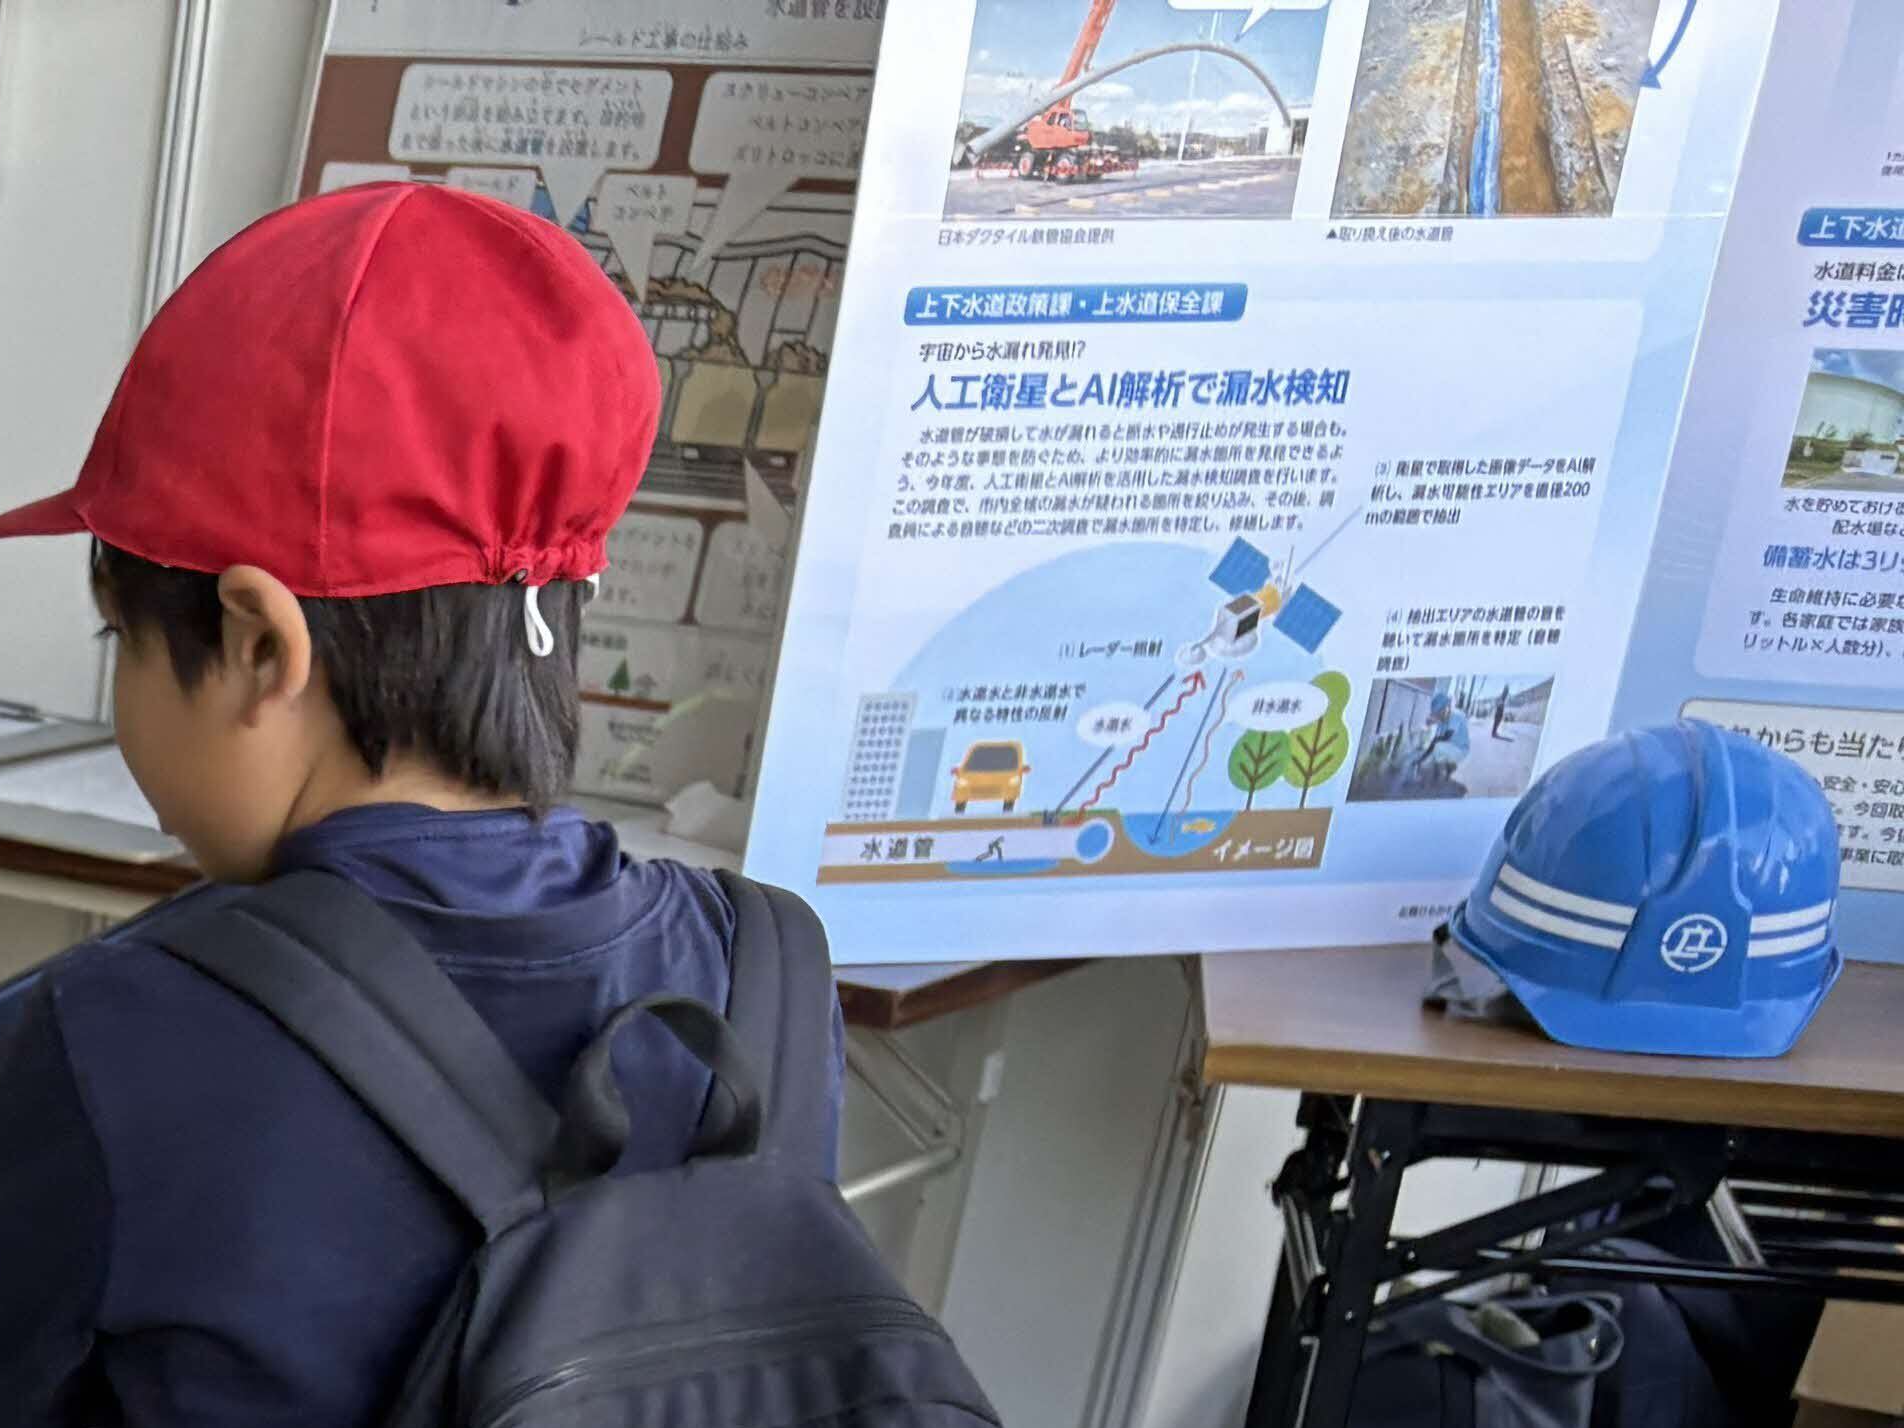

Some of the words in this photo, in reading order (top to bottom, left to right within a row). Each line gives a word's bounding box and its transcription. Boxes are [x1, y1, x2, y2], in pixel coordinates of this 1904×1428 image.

[910, 368, 1350, 411] 人工衛星とAI解析で漏水検知
[1762, 544, 1904, 573] 備蓄水は3リ
